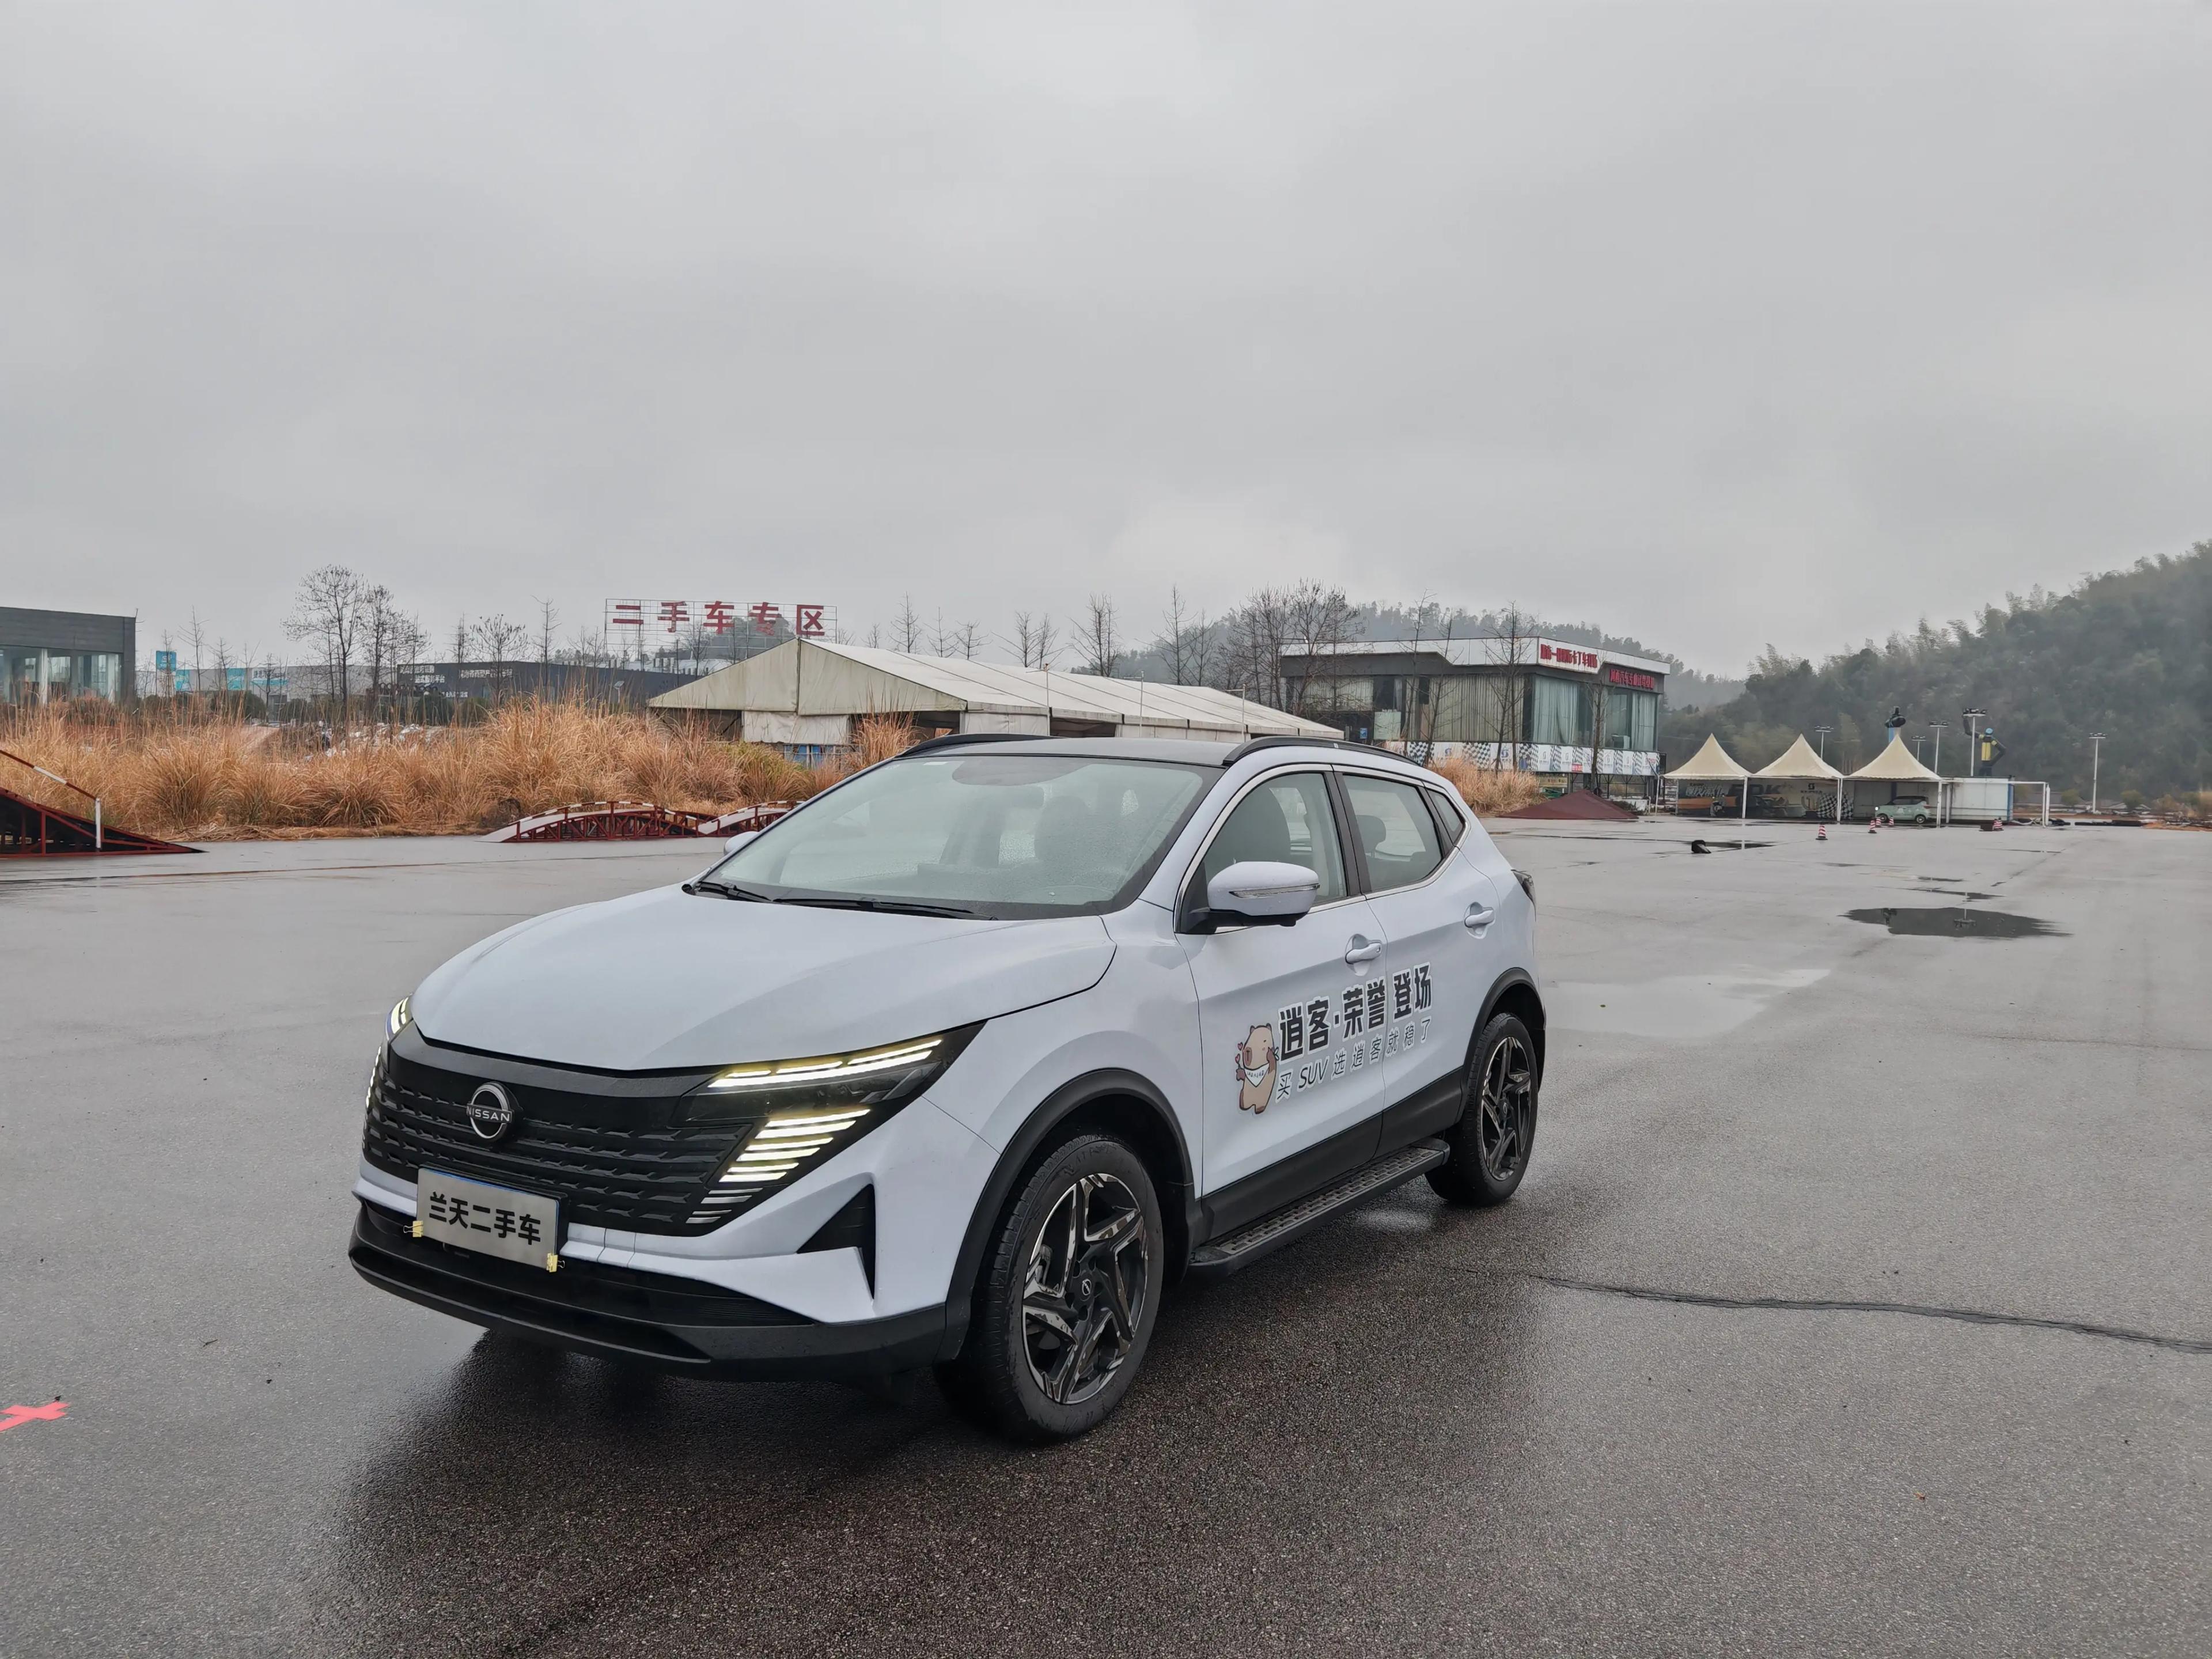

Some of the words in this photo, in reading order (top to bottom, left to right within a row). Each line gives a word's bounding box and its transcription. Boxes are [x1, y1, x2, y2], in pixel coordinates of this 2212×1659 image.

[612, 601, 825, 635] 二手车专区
[467, 1105, 510, 1122] NISSAN
[429, 1191, 541, 1245] 兰天二手车
